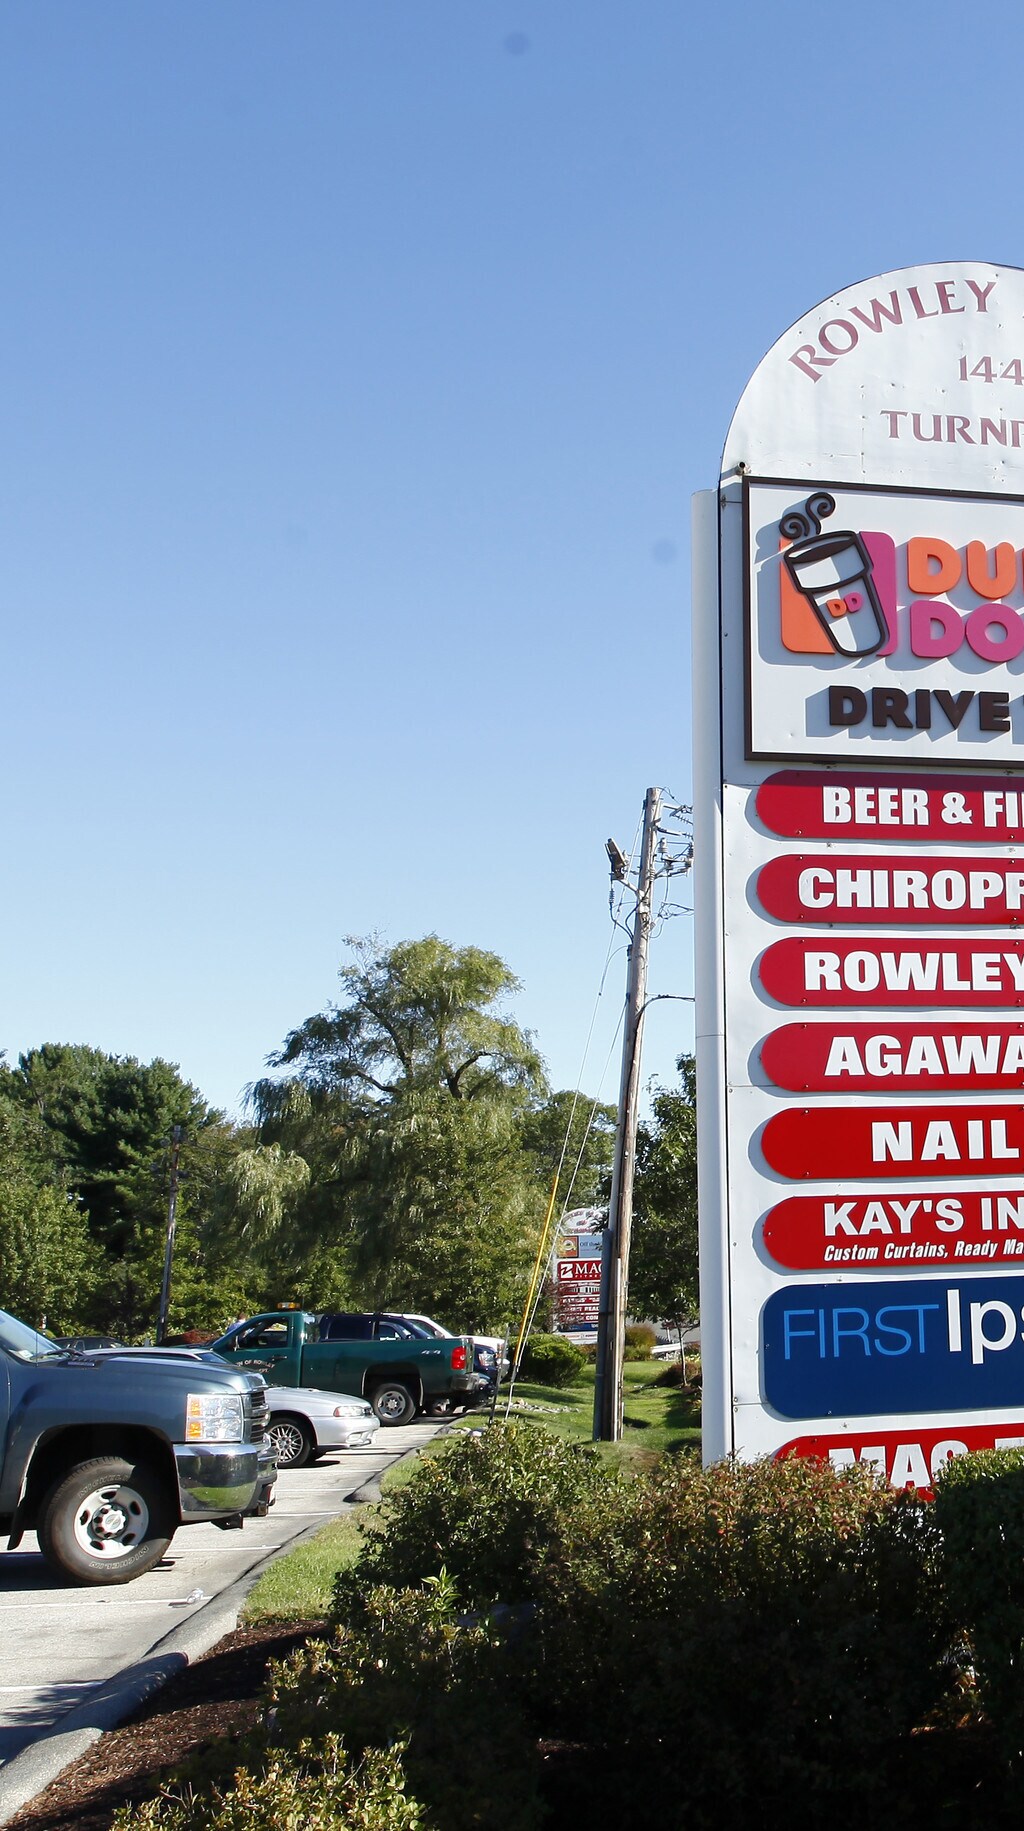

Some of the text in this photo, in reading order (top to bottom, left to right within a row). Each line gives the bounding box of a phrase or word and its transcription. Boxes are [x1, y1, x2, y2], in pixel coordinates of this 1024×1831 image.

[789, 280, 998, 383] ROWLEY
[826, 592, 864, 618] DD
[829, 685, 1011, 732] DRIVE
[822, 786, 929, 825] BEER
[941, 792, 973, 826] &
[871, 1118, 1021, 1162] NAIL
[823, 1198, 965, 1237] KAY'S
[823, 1244, 878, 1262] Custom
[884, 1242, 949, 1260] Curtains,
[954, 1239, 998, 1258] Ready
[783, 1304, 940, 1360] FIRST
